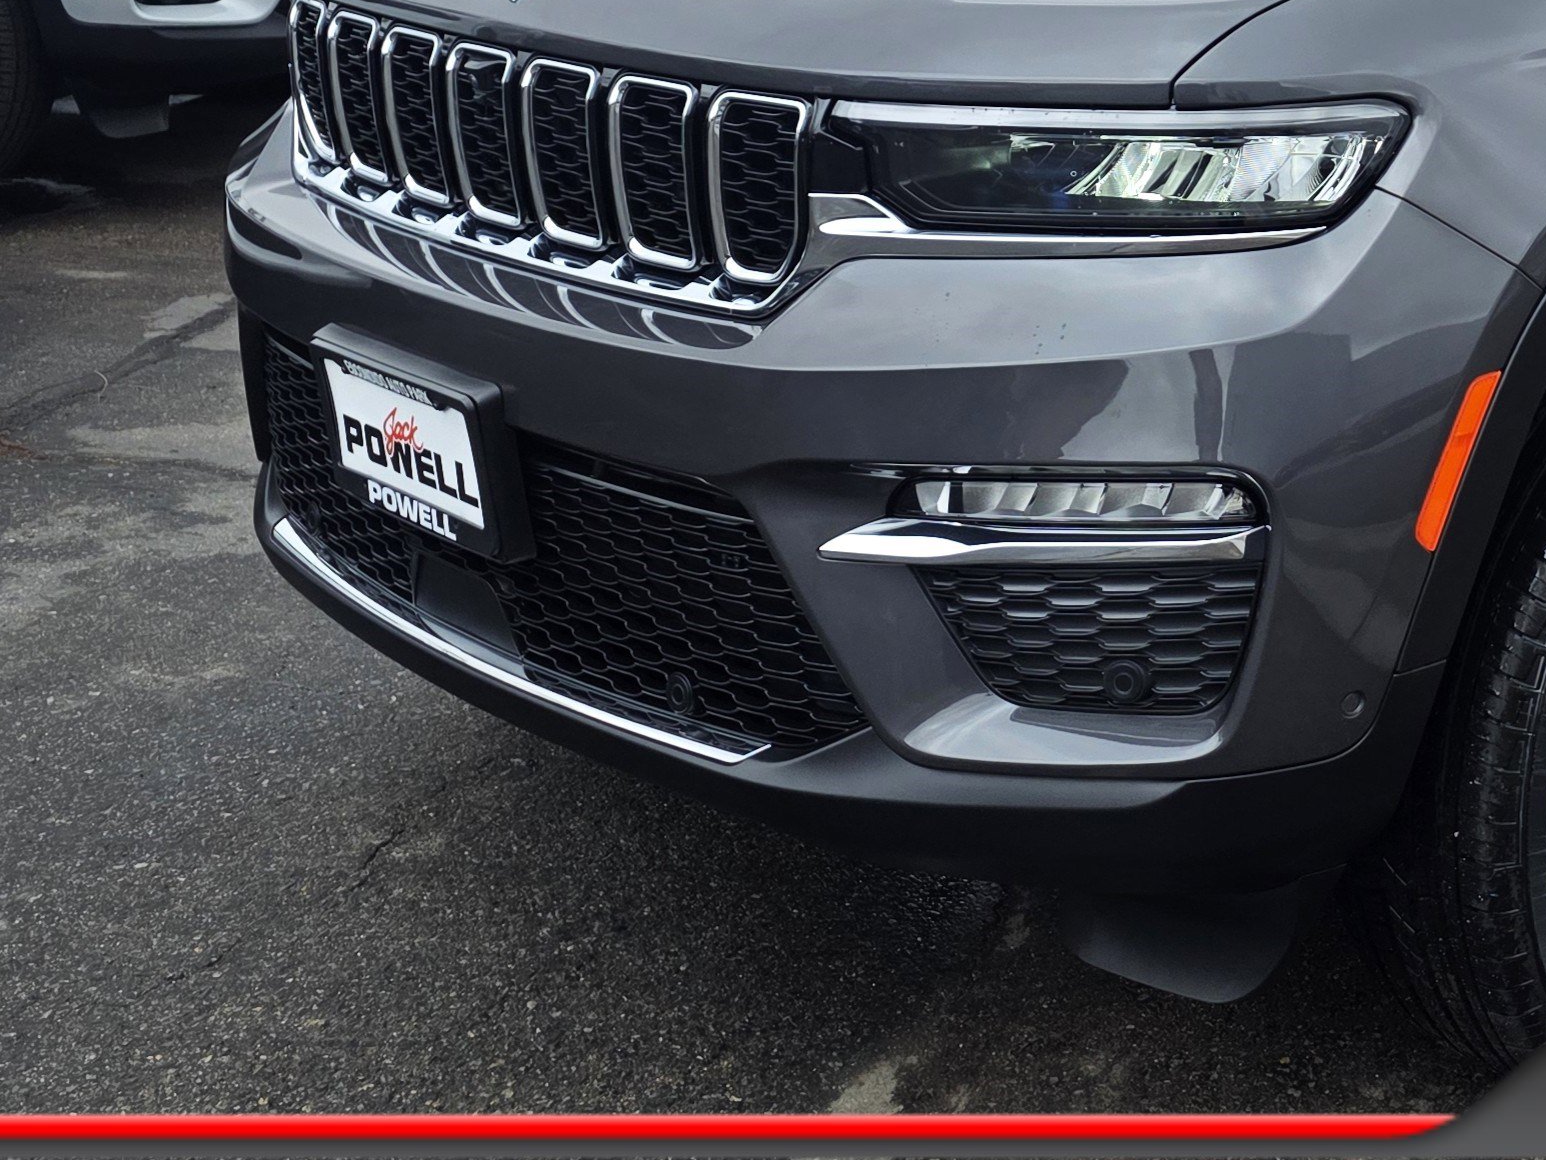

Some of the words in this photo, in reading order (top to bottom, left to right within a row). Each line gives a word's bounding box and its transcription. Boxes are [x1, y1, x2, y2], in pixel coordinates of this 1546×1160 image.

[343, 413, 480, 509] POWELL
[383, 407, 424, 457] Jack
[366, 479, 457, 542] POWELL
